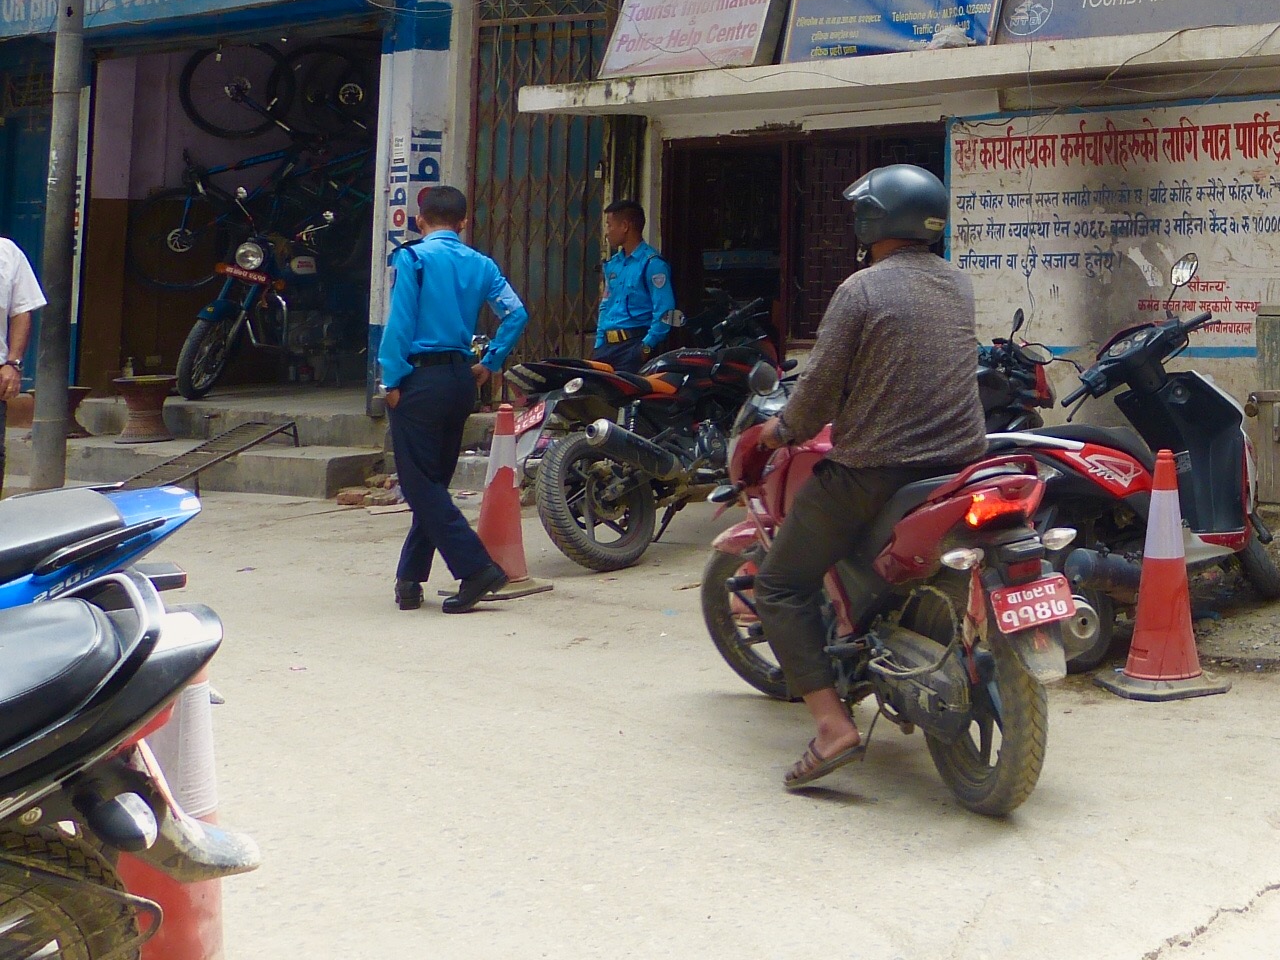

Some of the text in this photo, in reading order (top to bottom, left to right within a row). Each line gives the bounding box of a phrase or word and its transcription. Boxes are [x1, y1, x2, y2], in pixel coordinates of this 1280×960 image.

[628, 3, 677, 22] Tourist
[892, 10, 927, 23] Telephone
[616, 21, 758, 52] Police Help Centre
[913, 23, 934, 35] Traffic
[979, 126, 1059, 170] कार्यालयका
[1162, 116, 1200, 164] लागि
[1202, 123, 1232, 161] मात्र
[956, 190, 977, 214] यहाँ
[979, 189, 1004, 213] फोहर
[1062, 184, 1091, 210] मनाही
[1150, 180, 1168, 204] यदि
[1169, 179, 1193, 206] कोहि
[1228, 178, 1254, 205] फोहर
[957, 217, 983, 246] फोहर
[986, 216, 1006, 239] मैला
[1053, 213, 1071, 238] ऐन
[1164, 219, 1171, 237] ३
[957, 248, 1003, 270] जरिवाना
[1006, 253, 1018, 270] वा
[1041, 253, 1080, 271] सजाय
[1198, 295, 1232, 313] सहकारी
